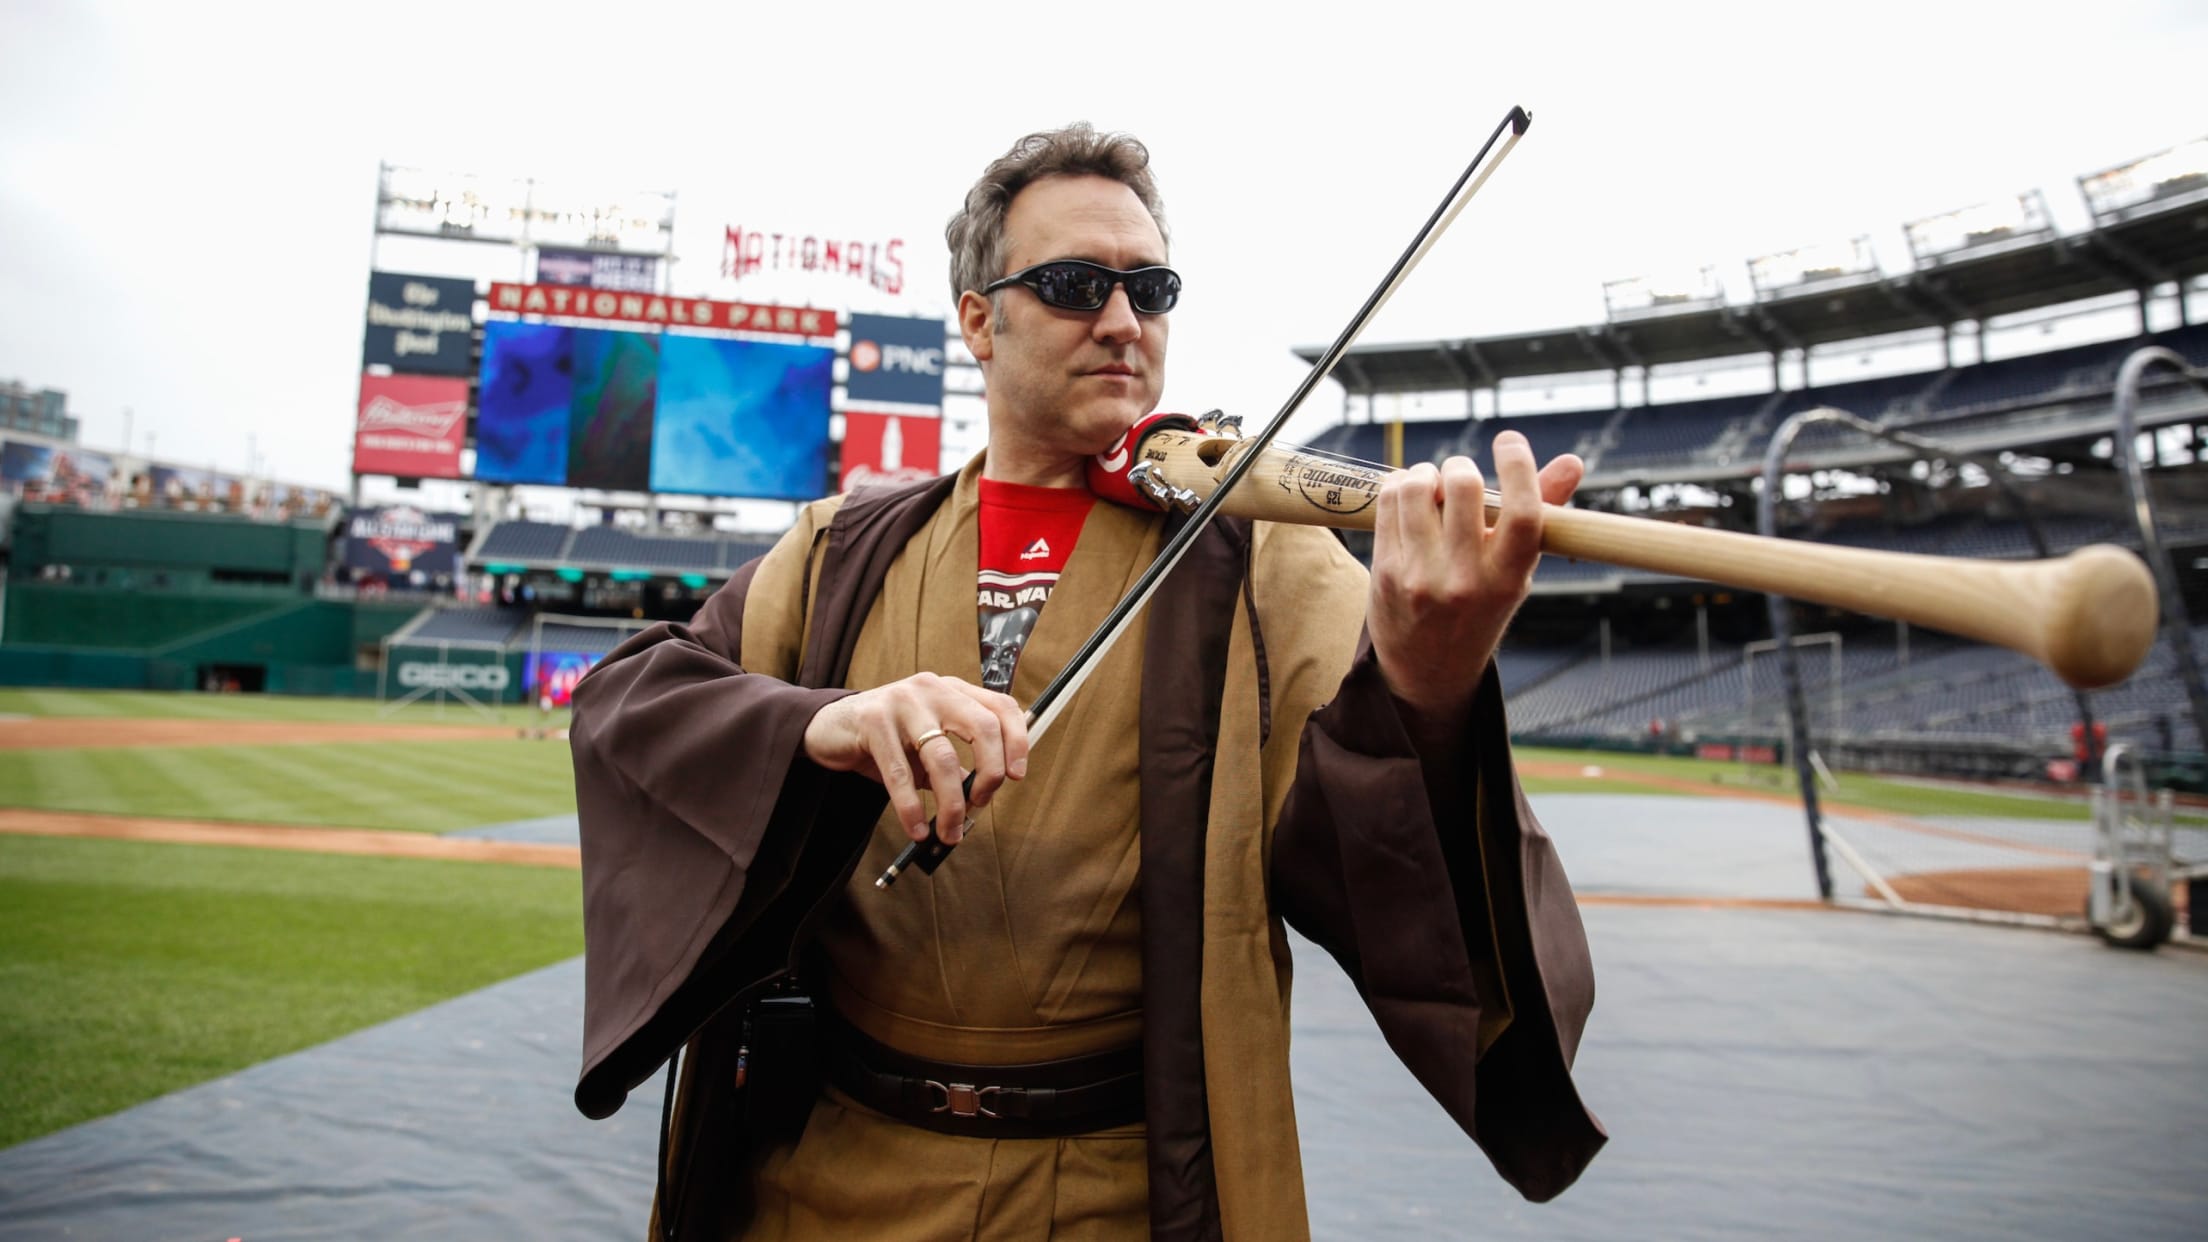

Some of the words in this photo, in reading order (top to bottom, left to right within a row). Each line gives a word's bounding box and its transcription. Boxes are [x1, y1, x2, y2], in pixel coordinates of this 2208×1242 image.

[721, 224, 904, 296] NATIONALS
[498, 285, 713, 325] NATIONALS
[728, 304, 820, 333] PARK
[882, 344, 943, 376] PNC
[1326, 490, 1342, 505] 125
[398, 661, 510, 690] GEICO
